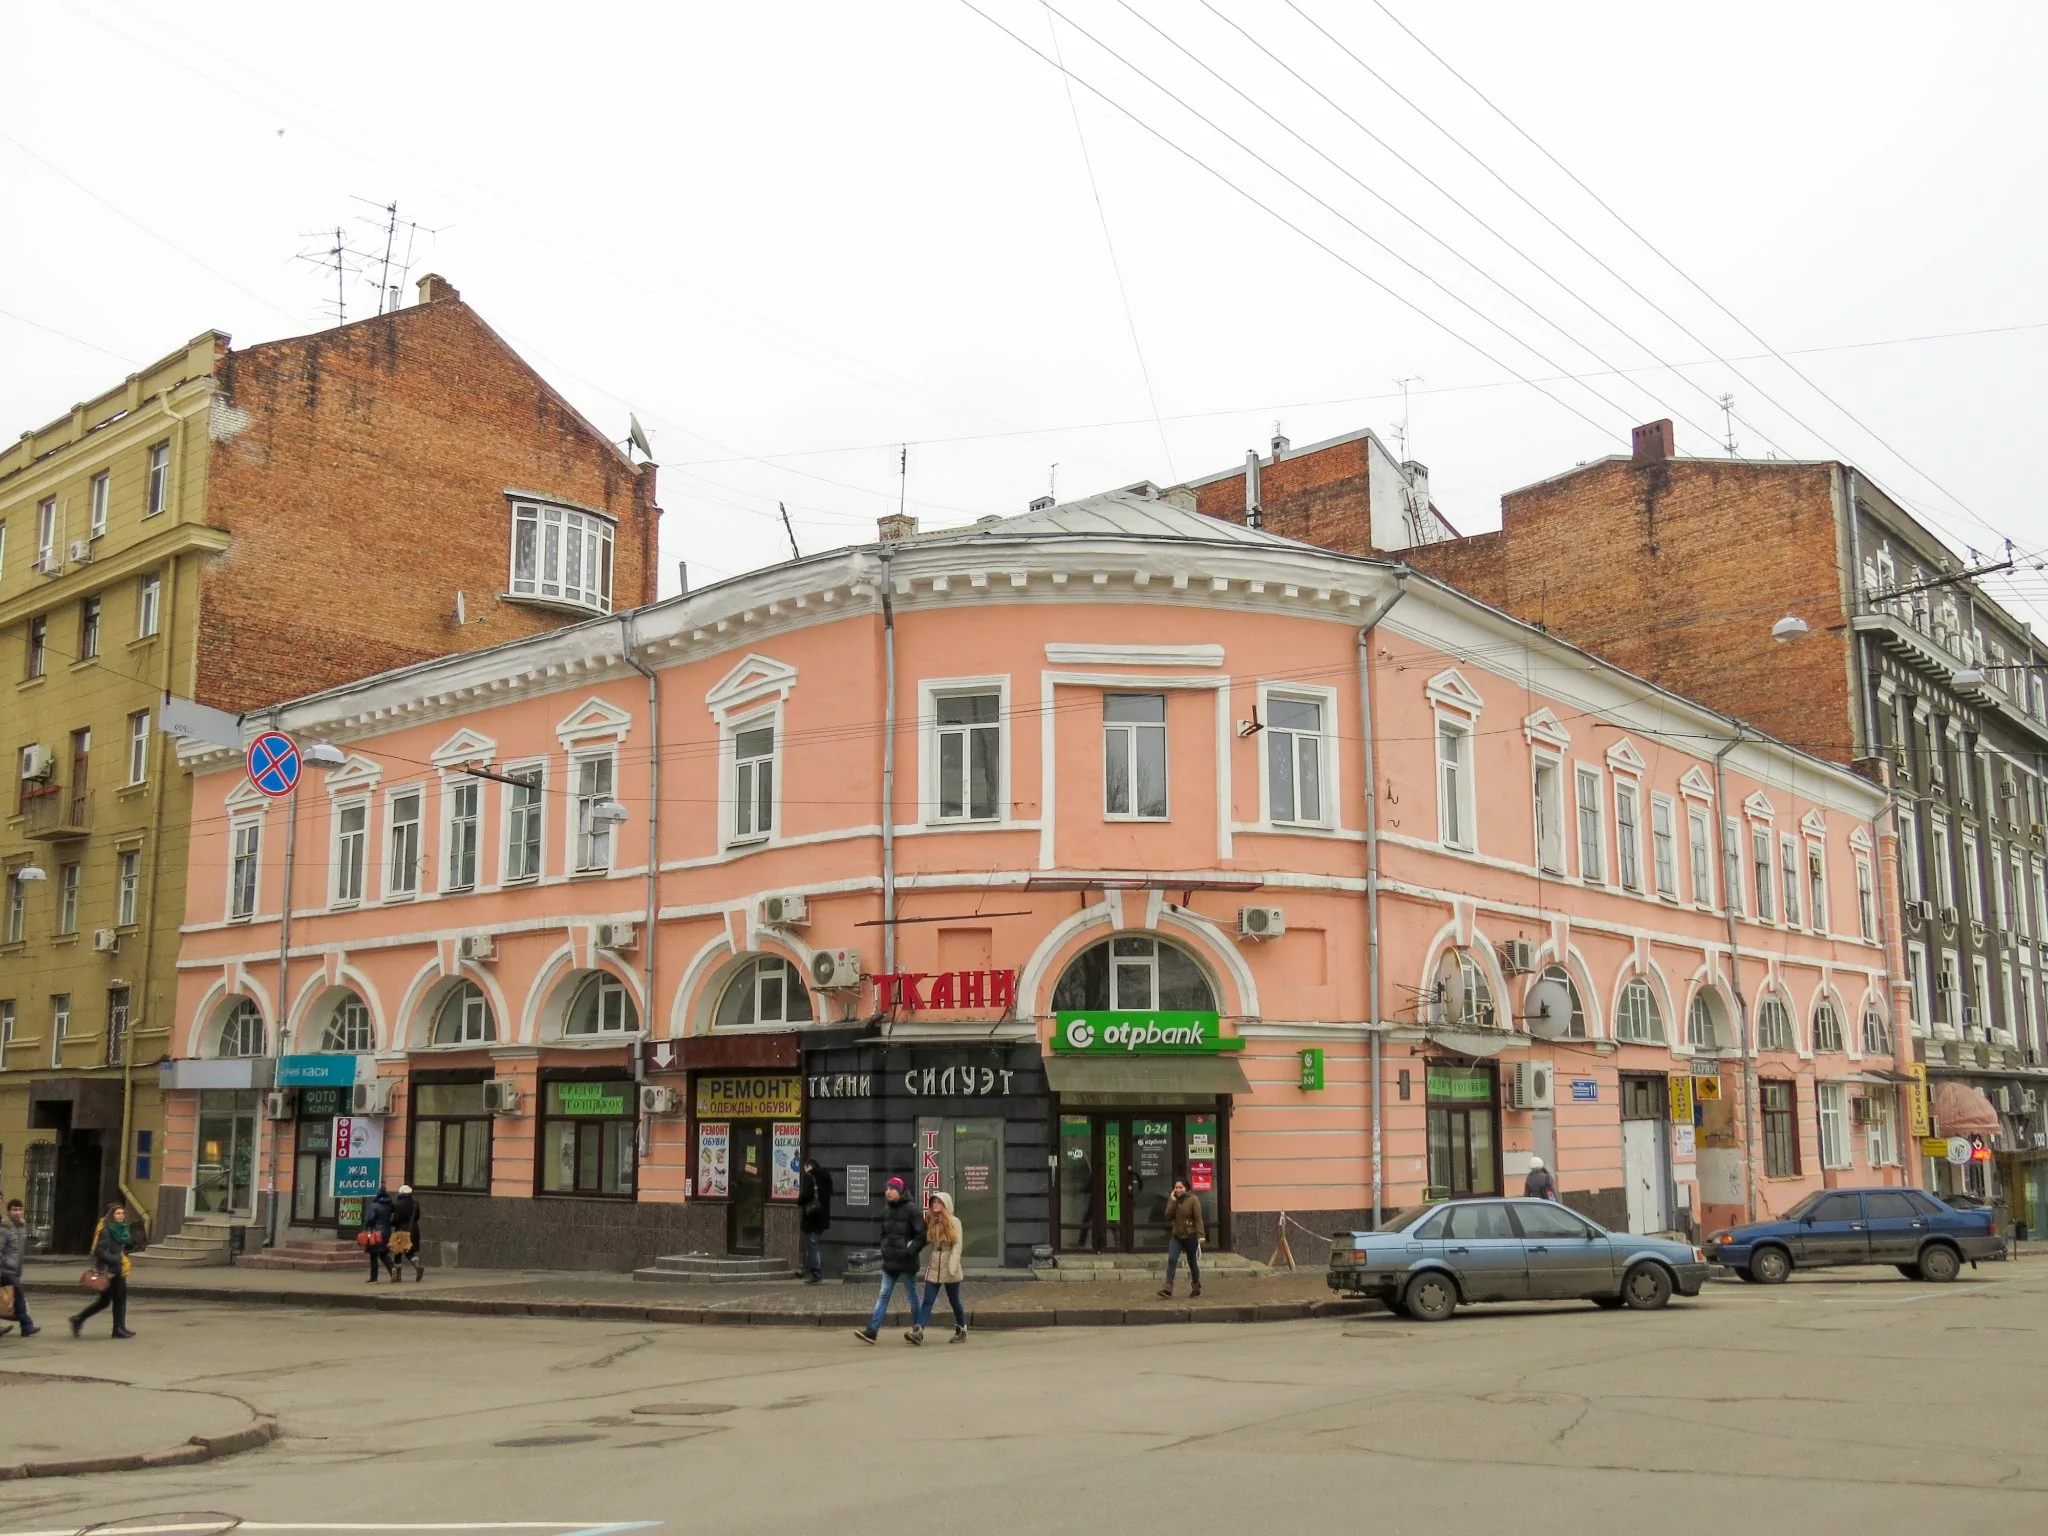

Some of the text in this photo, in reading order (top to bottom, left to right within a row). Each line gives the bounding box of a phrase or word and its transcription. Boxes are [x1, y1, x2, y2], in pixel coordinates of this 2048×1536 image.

[873, 970, 1015, 1012] ТКАНИ
[1103, 1019, 1203, 1050] otpbank
[302, 1067, 329, 1077] каси
[808, 1075, 871, 1099] ТКАНИ
[904, 1066, 1014, 1096] СИЛУЭТ
[710, 1079, 793, 1099] РЕМОНТ
[1590, 1084, 1597, 1096] 11
[306, 1090, 337, 1103] ФОТО
[710, 1101, 793, 1115] ОДЕЖДЫ ОБУВИ
[701, 1124, 728, 1136] РЕМОНТ
[1144, 1123, 1168, 1135] 0-24
[338, 1119, 349, 1157] ФОТО
[702, 1137, 726, 1147] ОБУВИ
[348, 1166, 368, 1176] Ж/Д
[1108, 1136, 1118, 1216] КРЕДИТ
[339, 1180, 375, 1188] КАССЫ
